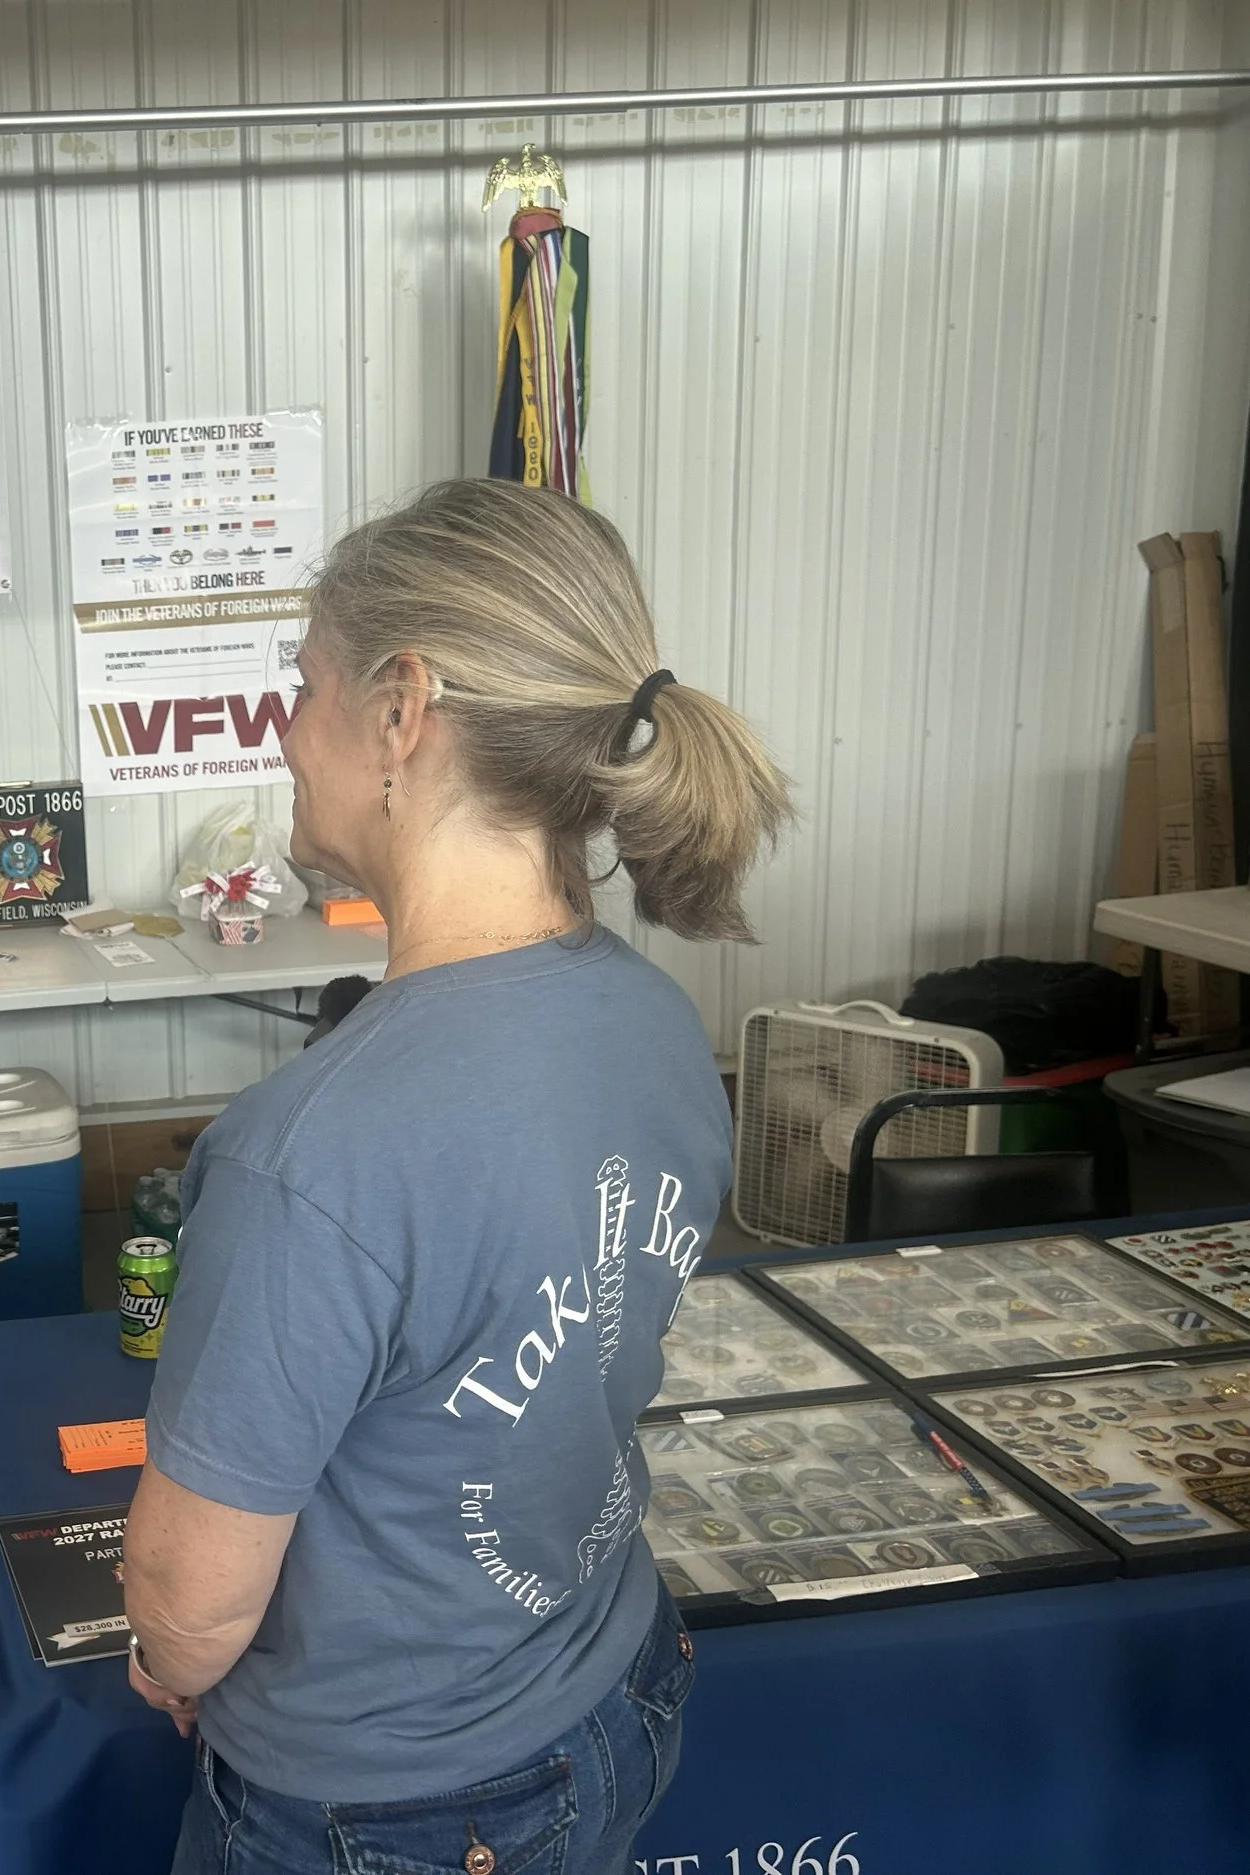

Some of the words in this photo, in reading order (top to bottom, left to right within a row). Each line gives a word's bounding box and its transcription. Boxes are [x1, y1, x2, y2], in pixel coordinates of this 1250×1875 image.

[125, 432, 134, 446] IF
[138, 428, 178, 445] YOU'VE
[181, 425, 226, 443] EARNED
[229, 422, 264, 439] THESE
[190, 572, 233, 590] BELONG
[236, 570, 265, 586] HERE
[95, 608, 120, 624] JOIN
[146, 604, 202, 621] VETERANS
[204, 602, 218, 618] OF
[220, 598, 269, 616] FOREIGN
[118, 691, 300, 756] VFW
[110, 764, 179, 782] VETERANS
[182, 763, 200, 776] OF
[202, 759, 259, 774] FOREIGN
[44, 790, 83, 814] 1866
[594, 1179, 636, 1270] It
[118, 1278, 166, 1328] tarry
[460, 1481, 493, 1522] For
[60, 1518, 128, 1534] DEPART
[53, 1533, 94, 1546] 2027
[85, 1547, 123, 1560] PART
[74, 1620, 112, 1634] $28,300
[114, 1619, 126, 1627] IN
[726, 1832, 860, 1875] 1866
